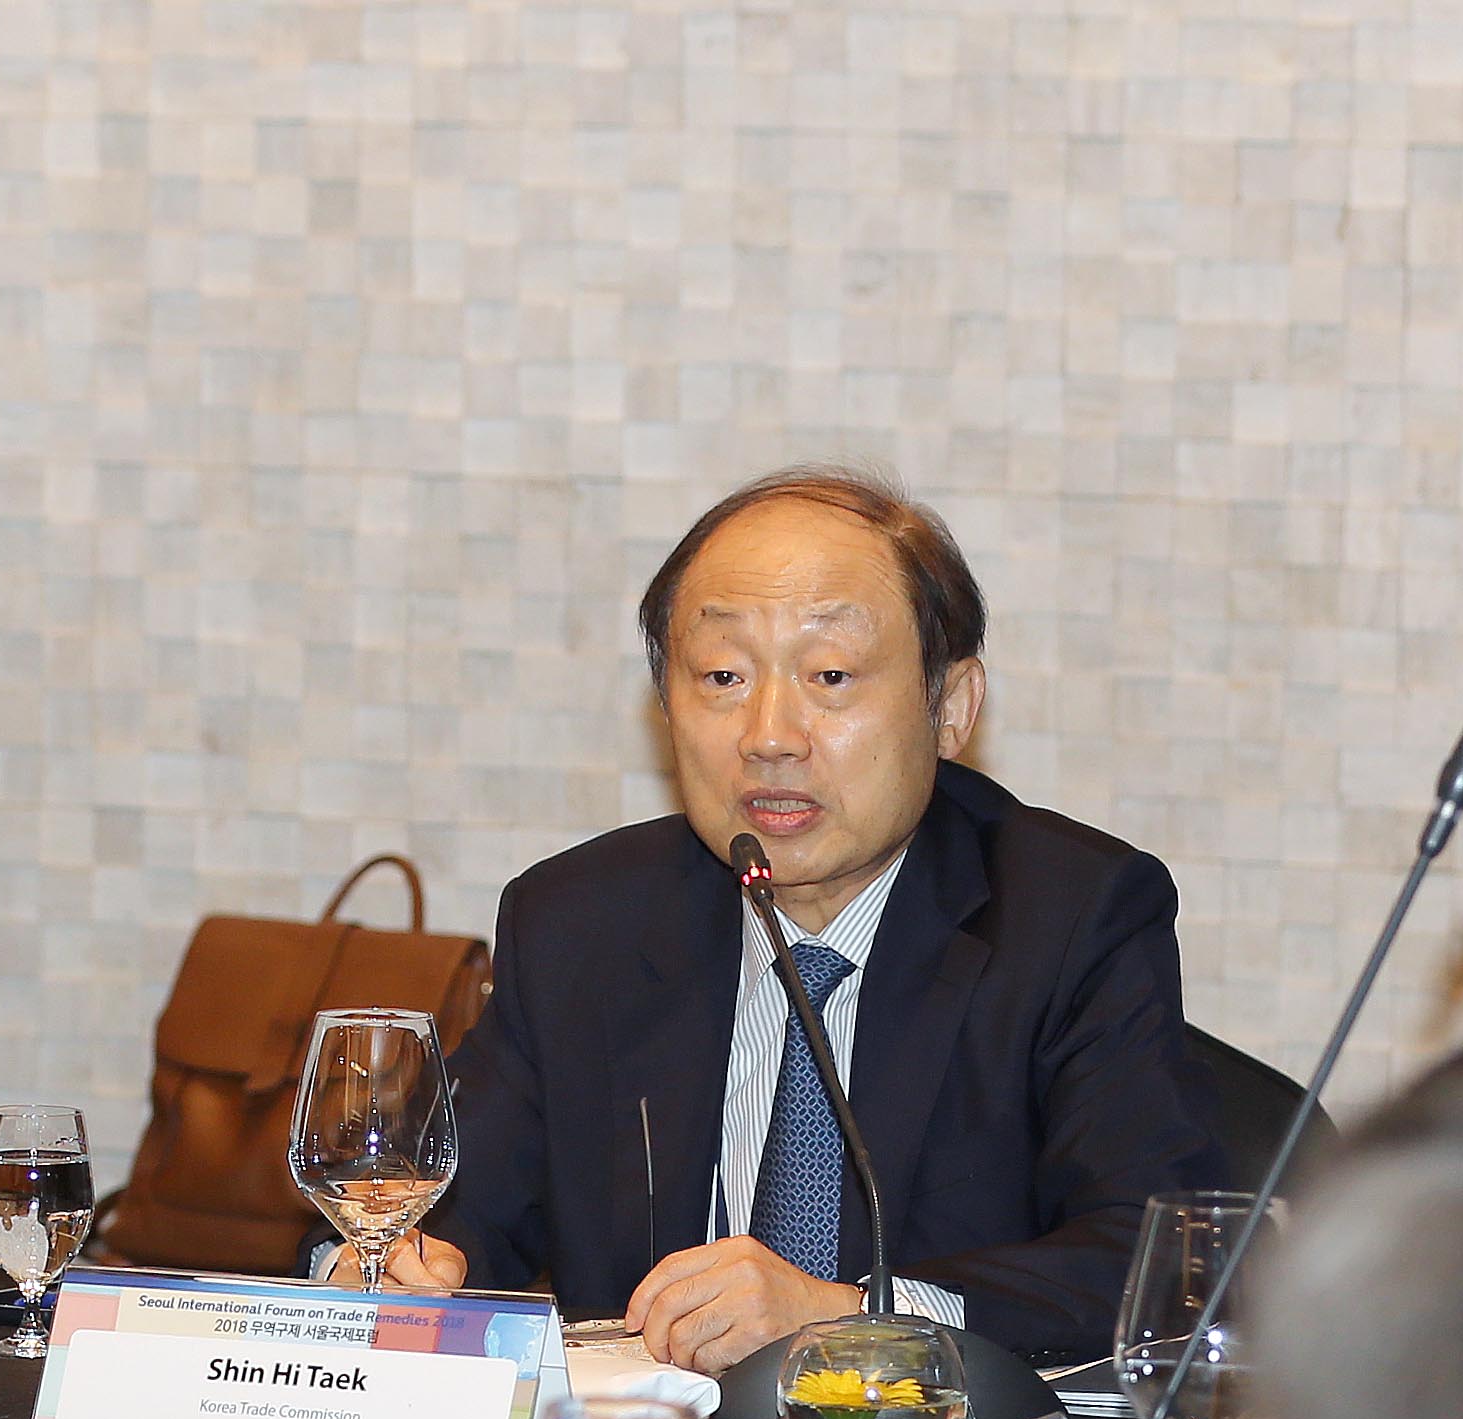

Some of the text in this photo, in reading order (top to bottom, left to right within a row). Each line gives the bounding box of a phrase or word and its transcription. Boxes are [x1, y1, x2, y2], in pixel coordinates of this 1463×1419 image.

[138, 1294, 465, 1329] Seoul International Forum on Trade Remedies 2018
[214, 1318, 380, 1344] 2018 무역구제 서울국제포럼
[207, 1358, 368, 1391] Shin Hi Taek
[199, 1399, 237, 1414] Korea
[240, 1402, 276, 1417] Trade
